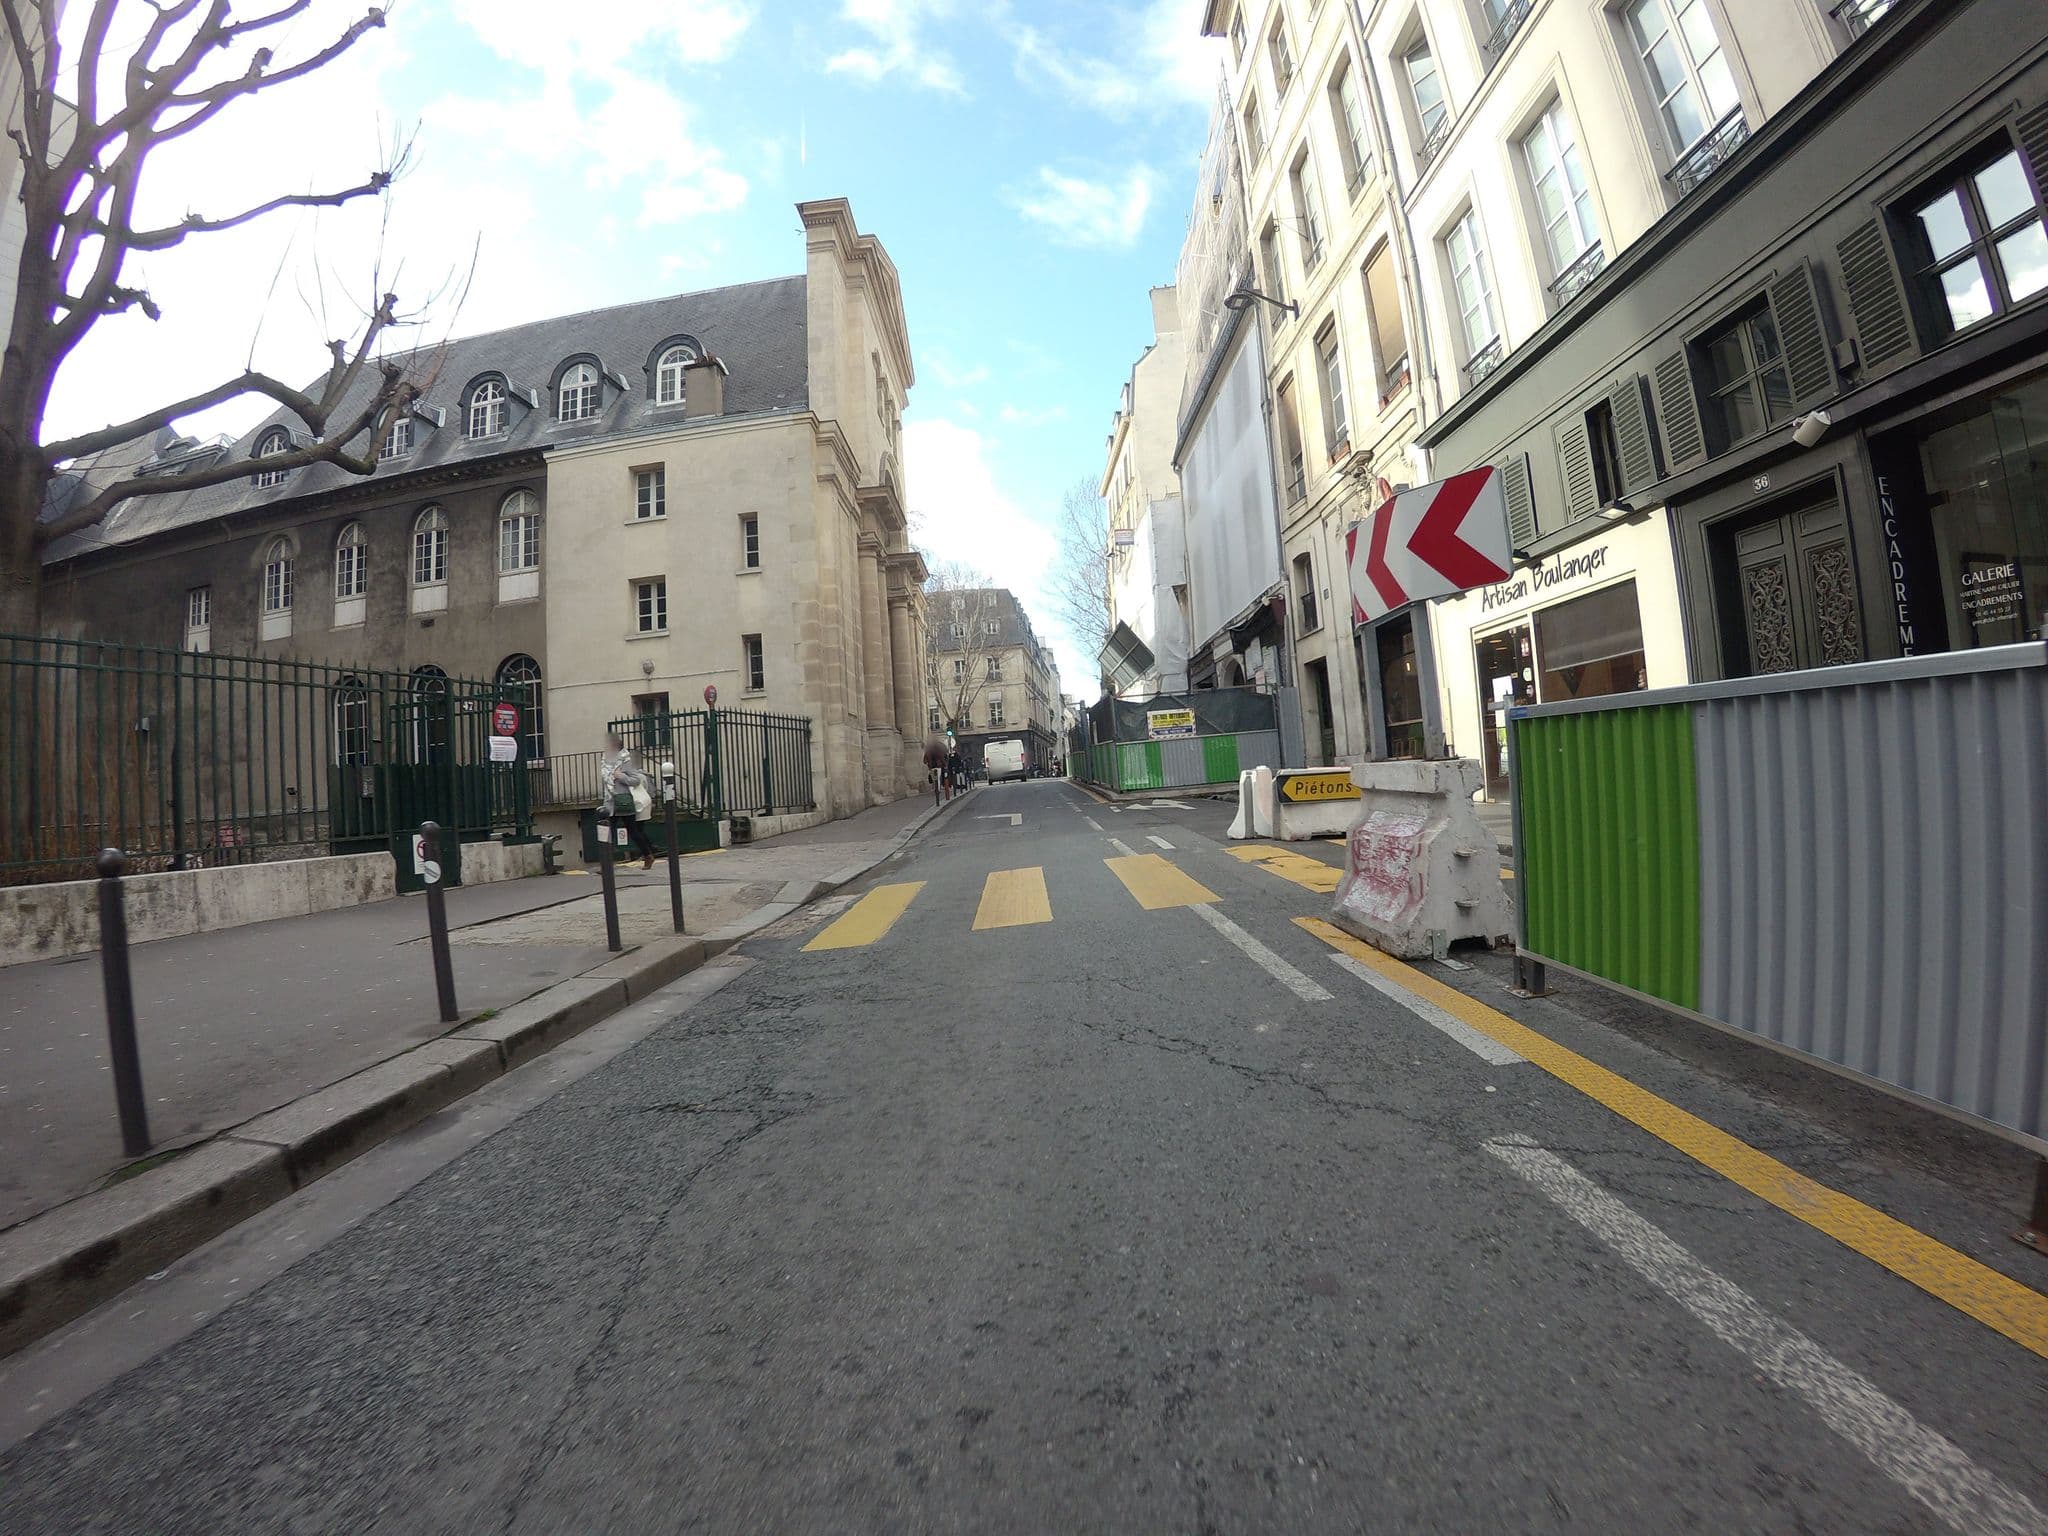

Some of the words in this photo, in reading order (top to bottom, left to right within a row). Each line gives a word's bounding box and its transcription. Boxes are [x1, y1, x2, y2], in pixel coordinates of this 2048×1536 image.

[1754, 476, 1768, 490] 36
[1482, 580, 1528, 613] Artisan
[1532, 546, 1609, 592] Boulanger
[1961, 563, 2016, 586] GALERIE
[1961, 592, 2023, 610] ENCADREMENTS
[1295, 781, 1353, 795] Piétons
